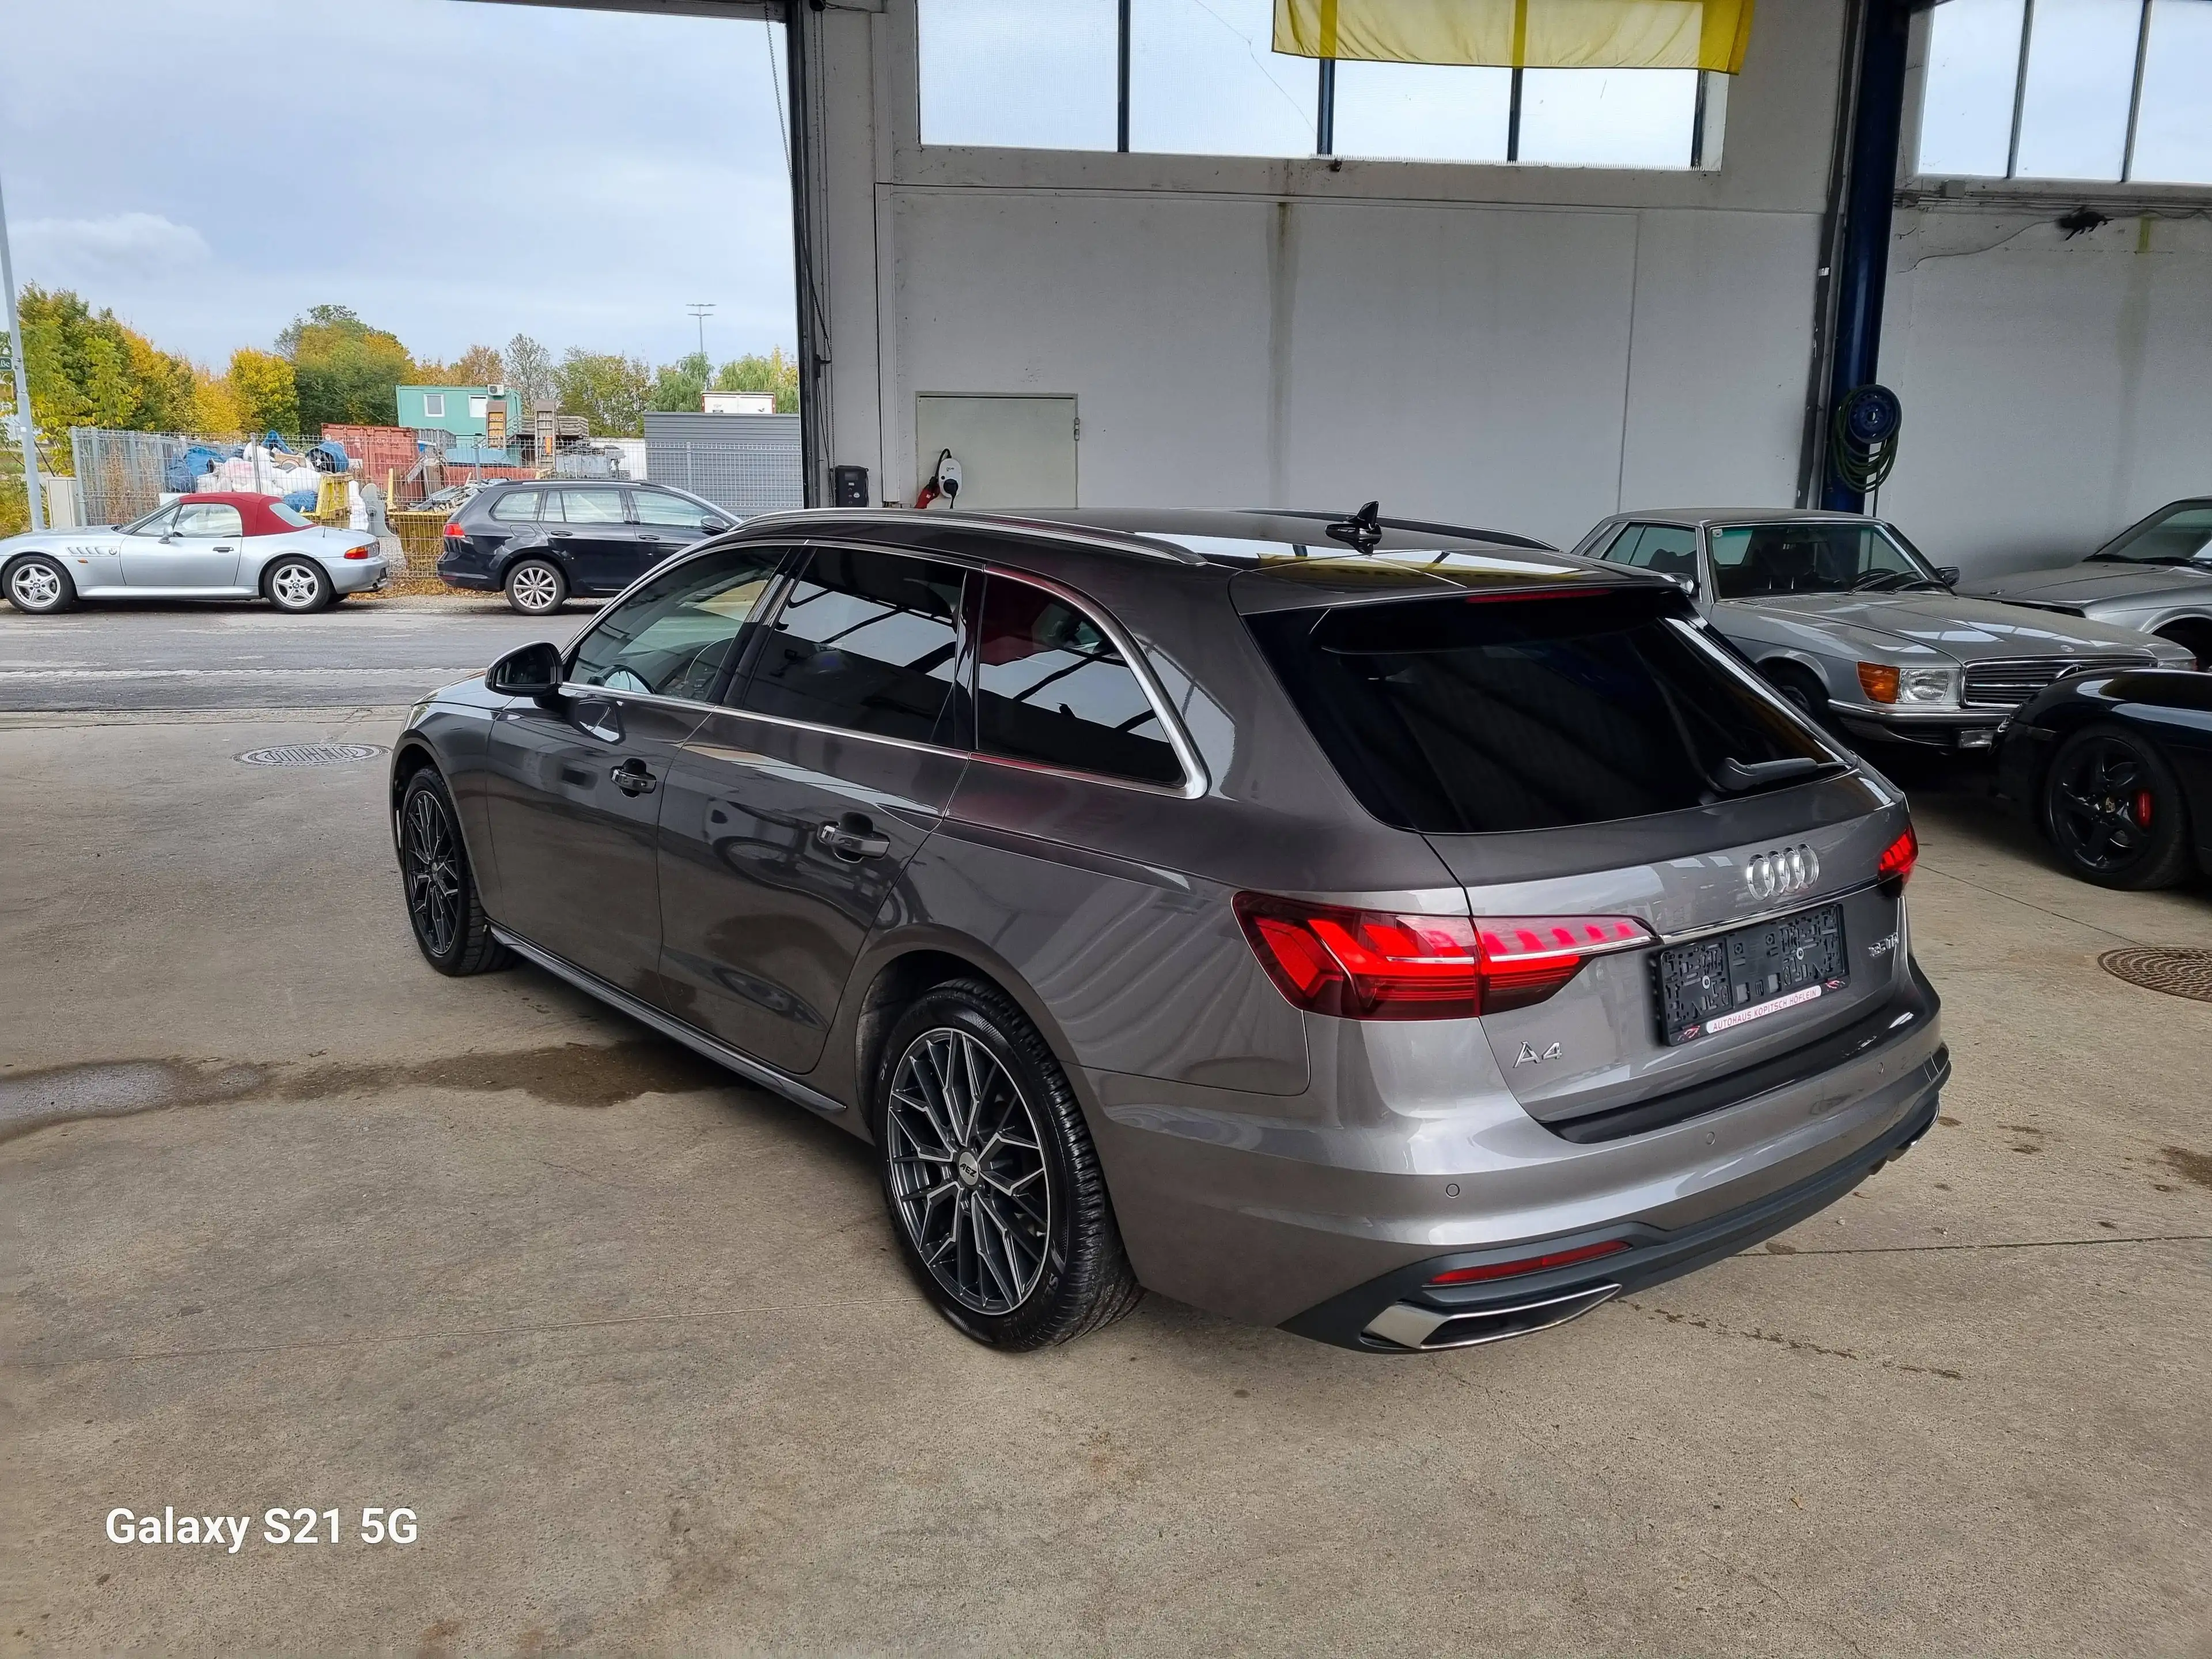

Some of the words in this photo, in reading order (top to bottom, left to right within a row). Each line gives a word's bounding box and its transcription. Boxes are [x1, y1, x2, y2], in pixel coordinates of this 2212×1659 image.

[1713, 1012, 1752, 1031] AUTOHAUS
[1753, 999, 1787, 1017] KOPITSCH
[1790, 988, 1816, 1005] HÖFLEIN
[1512, 1041, 1562, 1068] A4
[960, 1163, 977, 1177] AEZ
